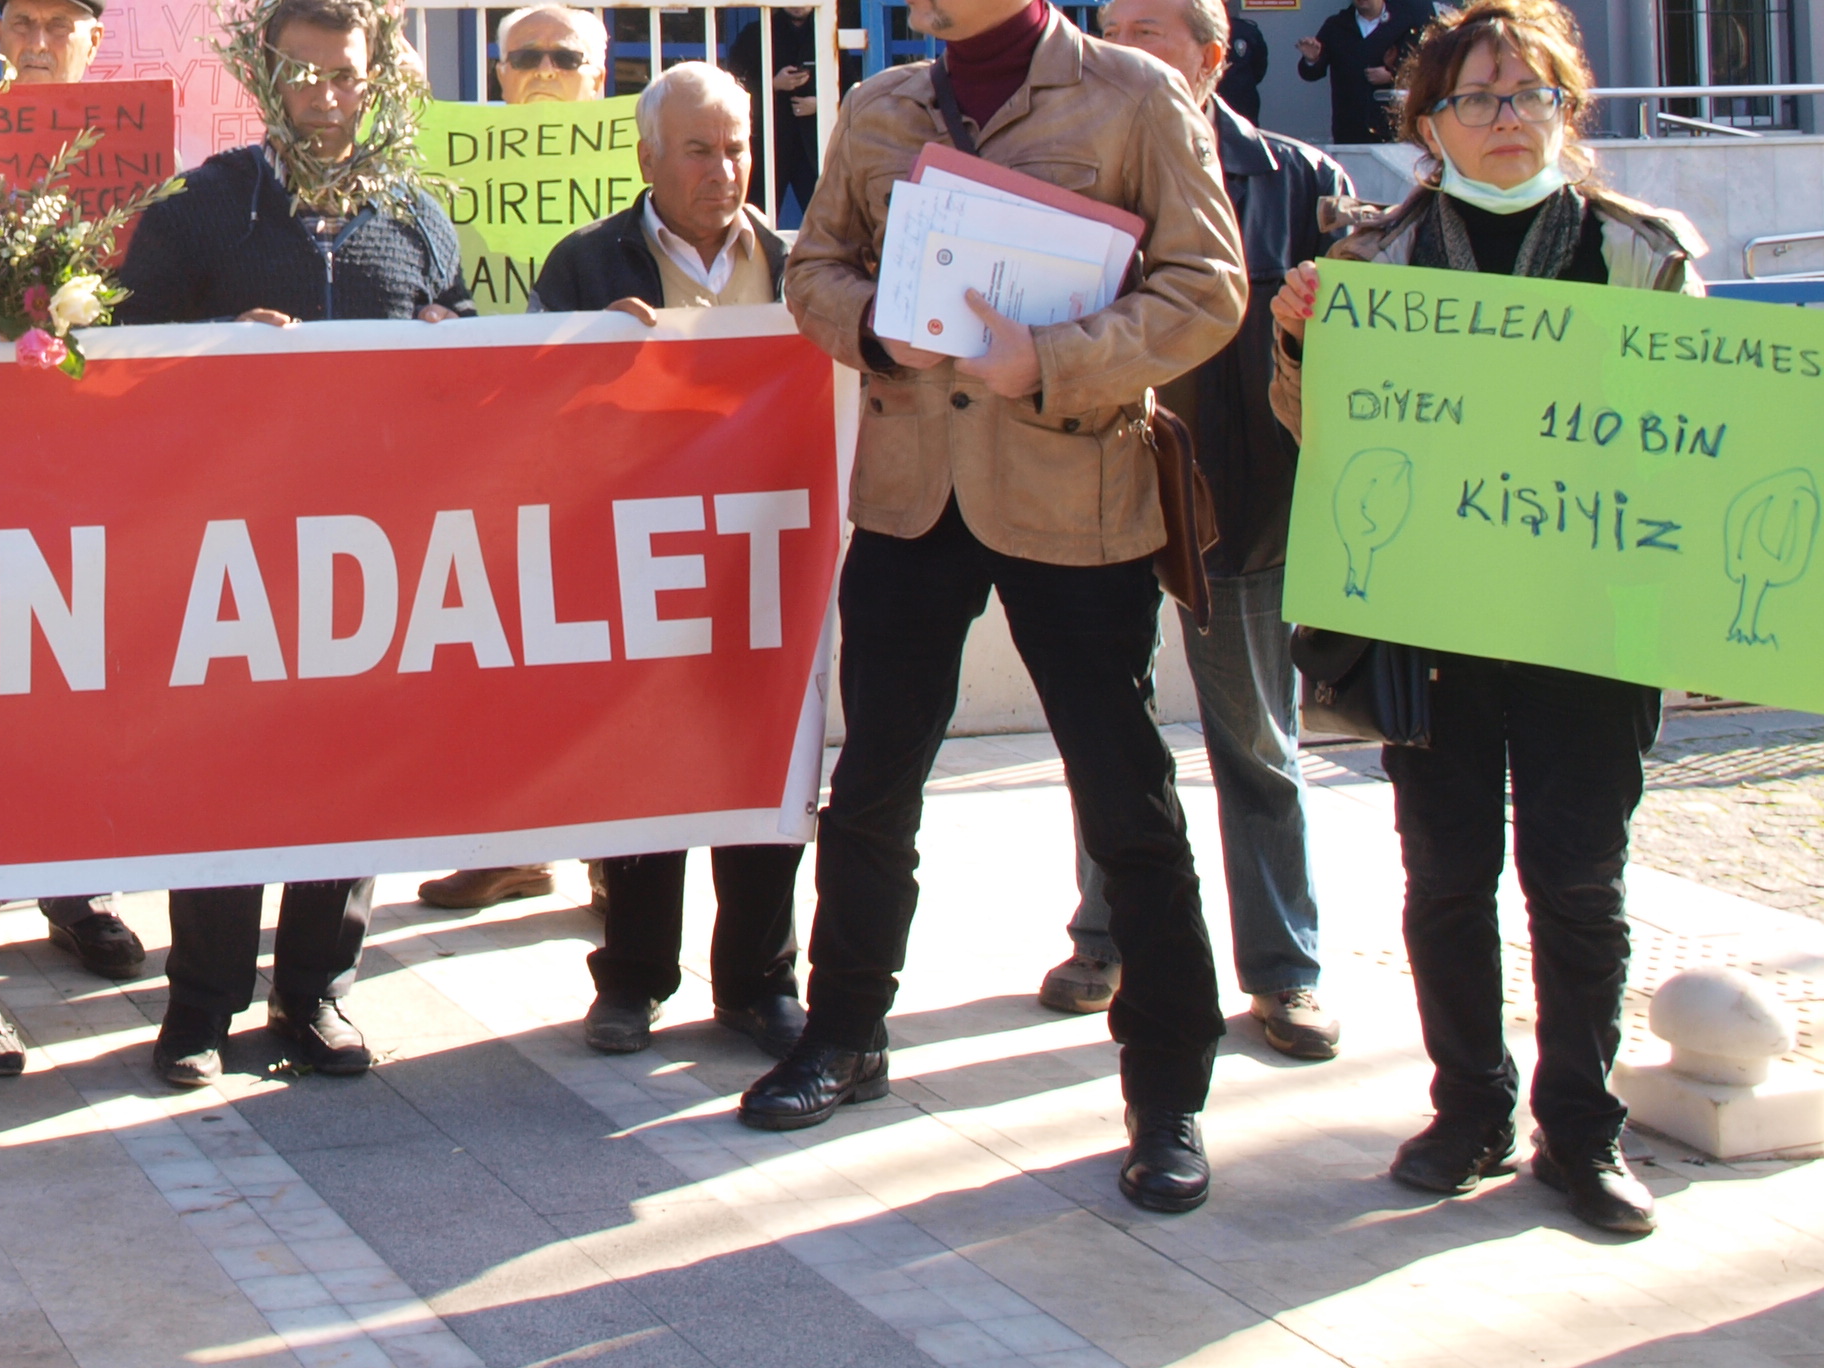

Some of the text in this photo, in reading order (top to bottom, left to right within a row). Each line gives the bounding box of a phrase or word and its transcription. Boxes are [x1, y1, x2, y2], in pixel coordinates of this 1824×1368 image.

[1321, 282, 1573, 343] AKBELEN
[1346, 380, 1727, 458] DİYEN 110 BİN
[1456, 472, 1683, 553] KİŞİYİZ
[169, 489, 811, 688] ADALET
